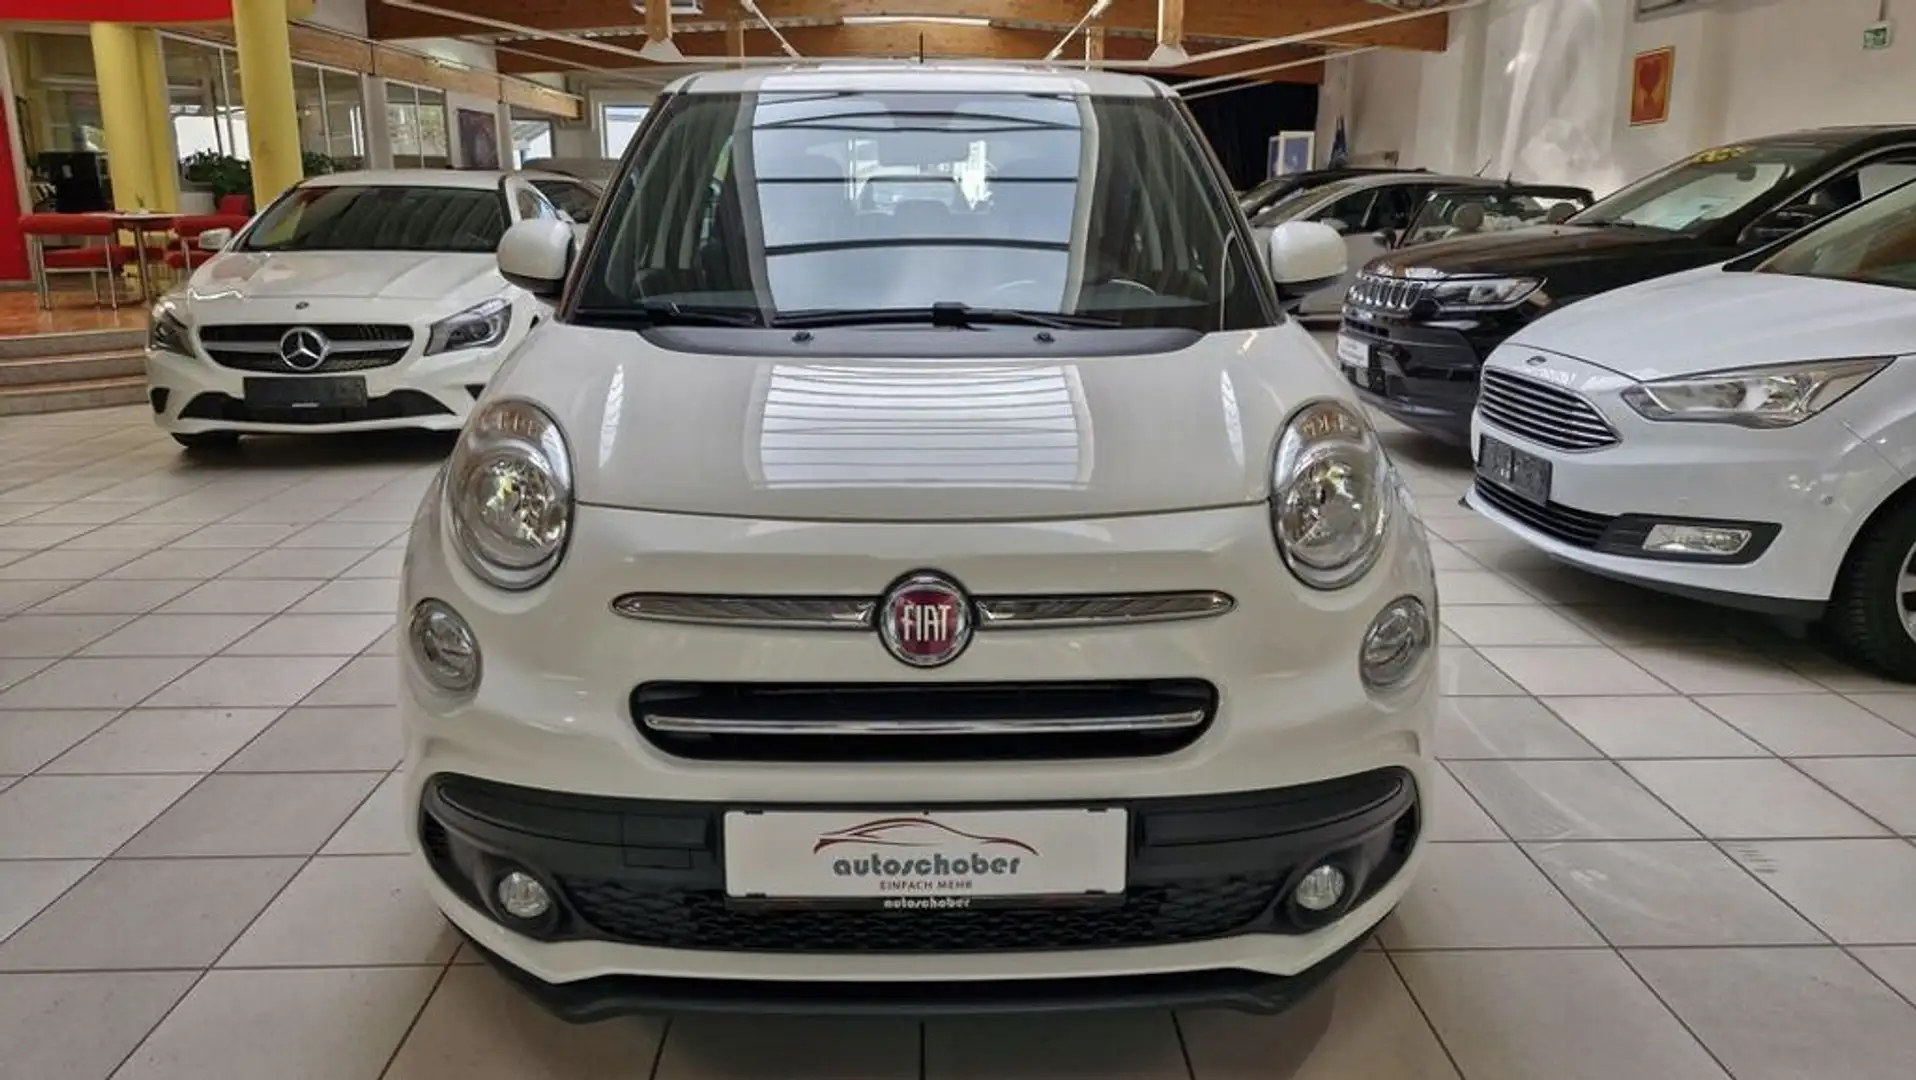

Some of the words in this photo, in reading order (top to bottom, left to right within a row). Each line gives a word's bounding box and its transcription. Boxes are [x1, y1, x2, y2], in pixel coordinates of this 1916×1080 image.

[901, 604, 952, 642] FIAT
[832, 853, 1021, 875] autoschober
[880, 880, 933, 891] EINFACH
[937, 880, 973, 891] MEHR
[883, 897, 971, 909] autoschober
